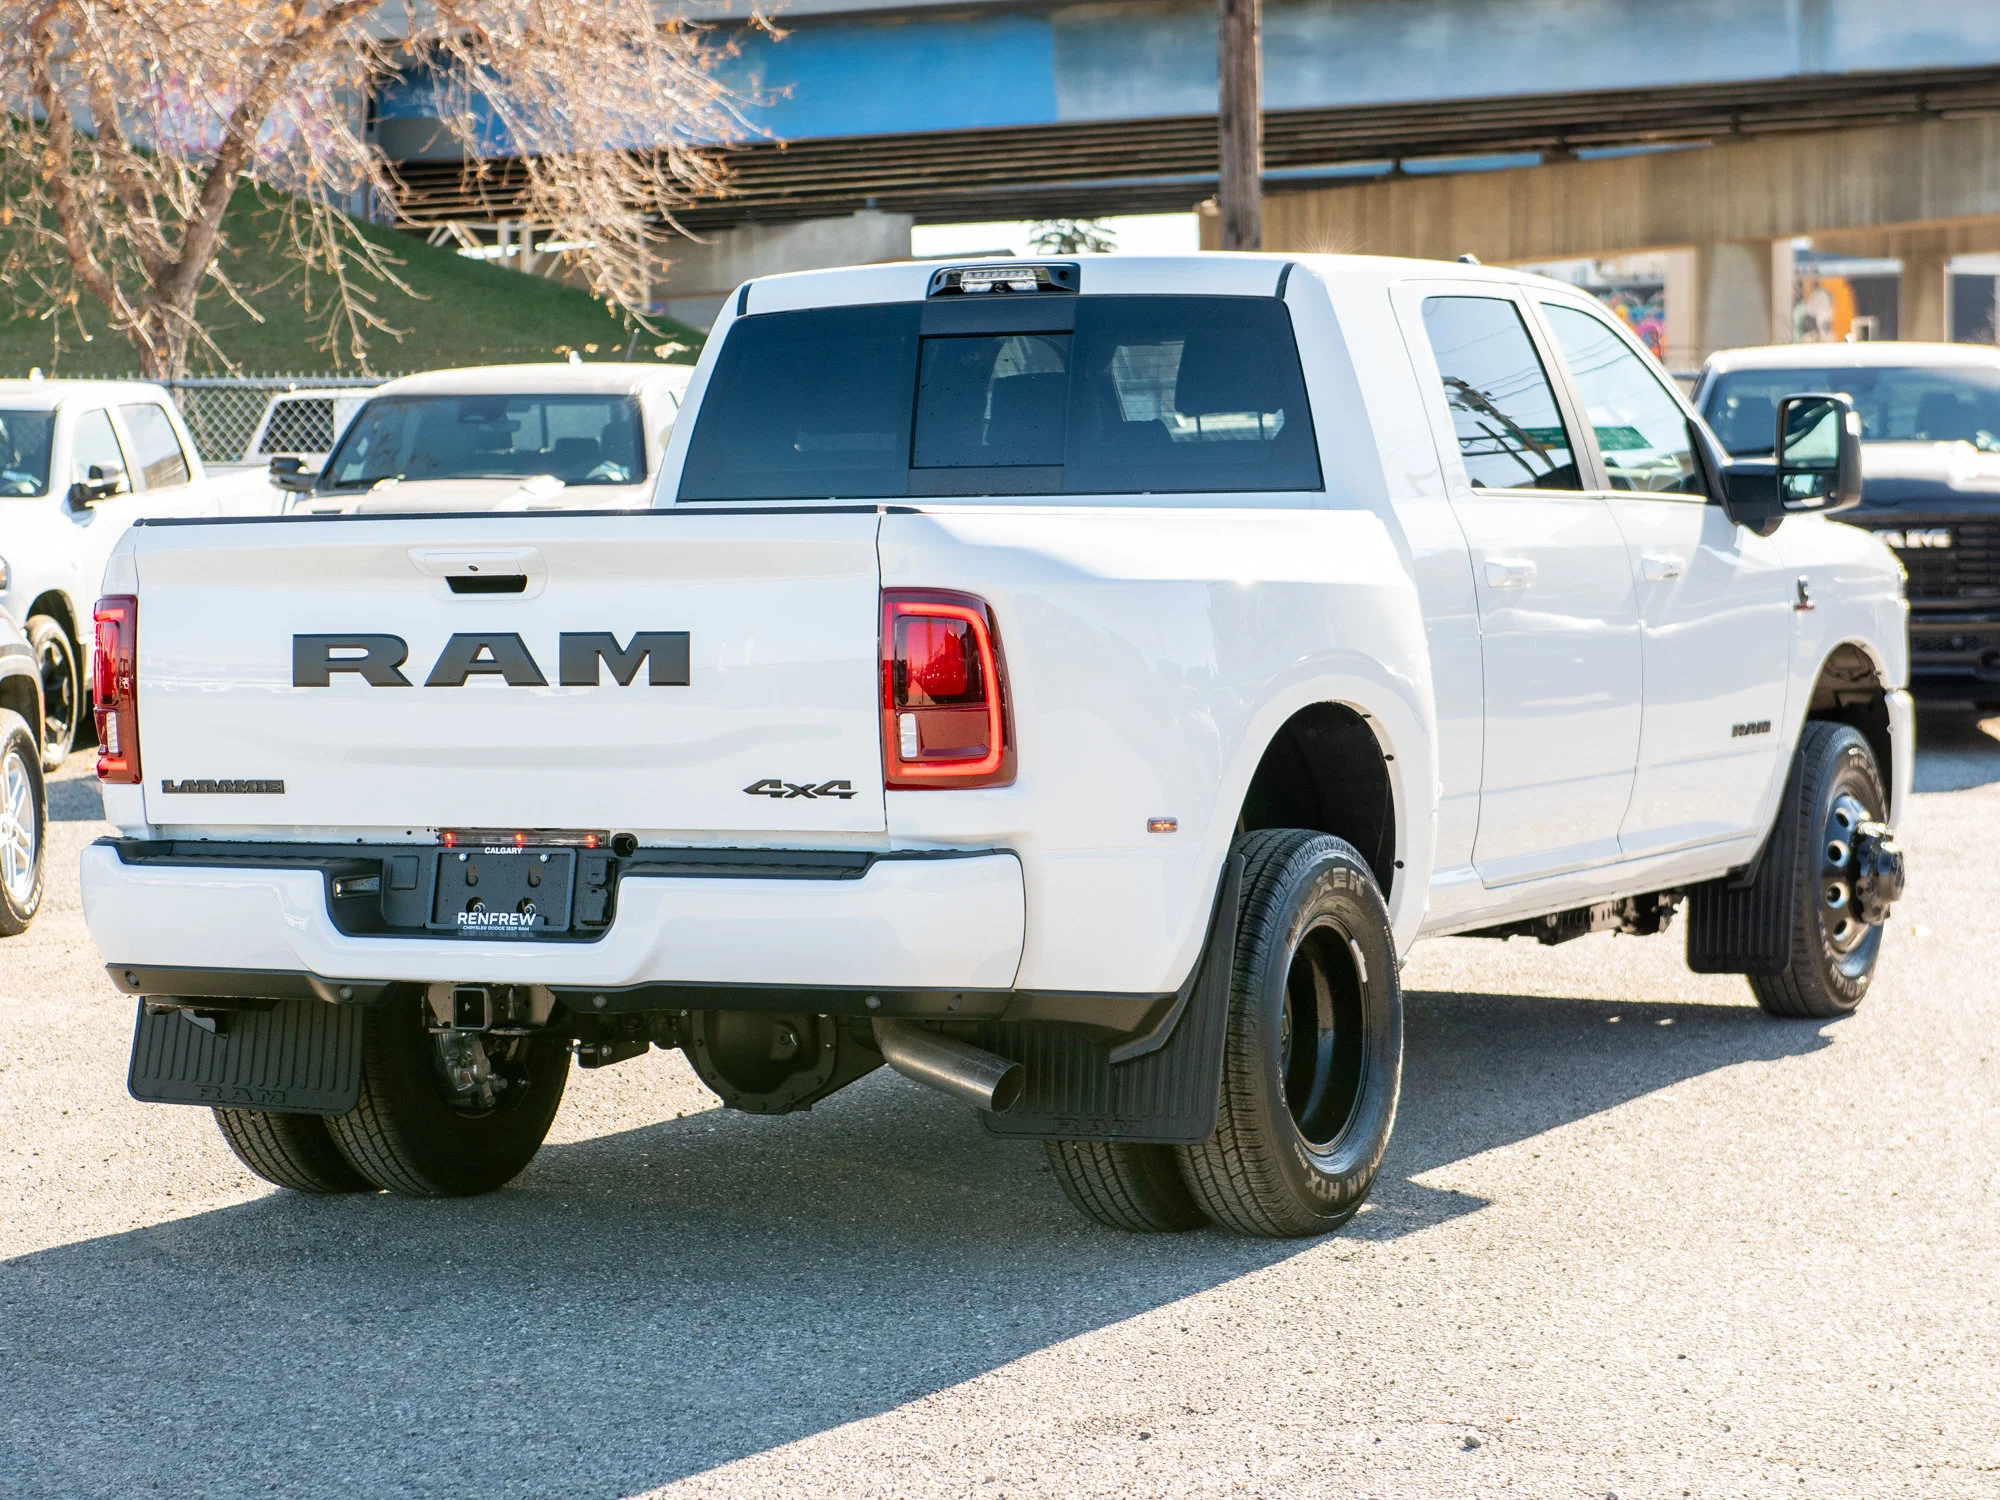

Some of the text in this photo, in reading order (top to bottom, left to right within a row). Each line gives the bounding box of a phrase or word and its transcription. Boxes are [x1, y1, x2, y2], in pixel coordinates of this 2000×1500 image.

[292, 631, 691, 688] RAM
[1731, 720, 1771, 738] RAM
[161, 779, 285, 794] LARAMIE
[742, 779, 858, 799] 4x4
[457, 912, 537, 926] RENFREW
[195, 1085, 286, 1103] RAM
